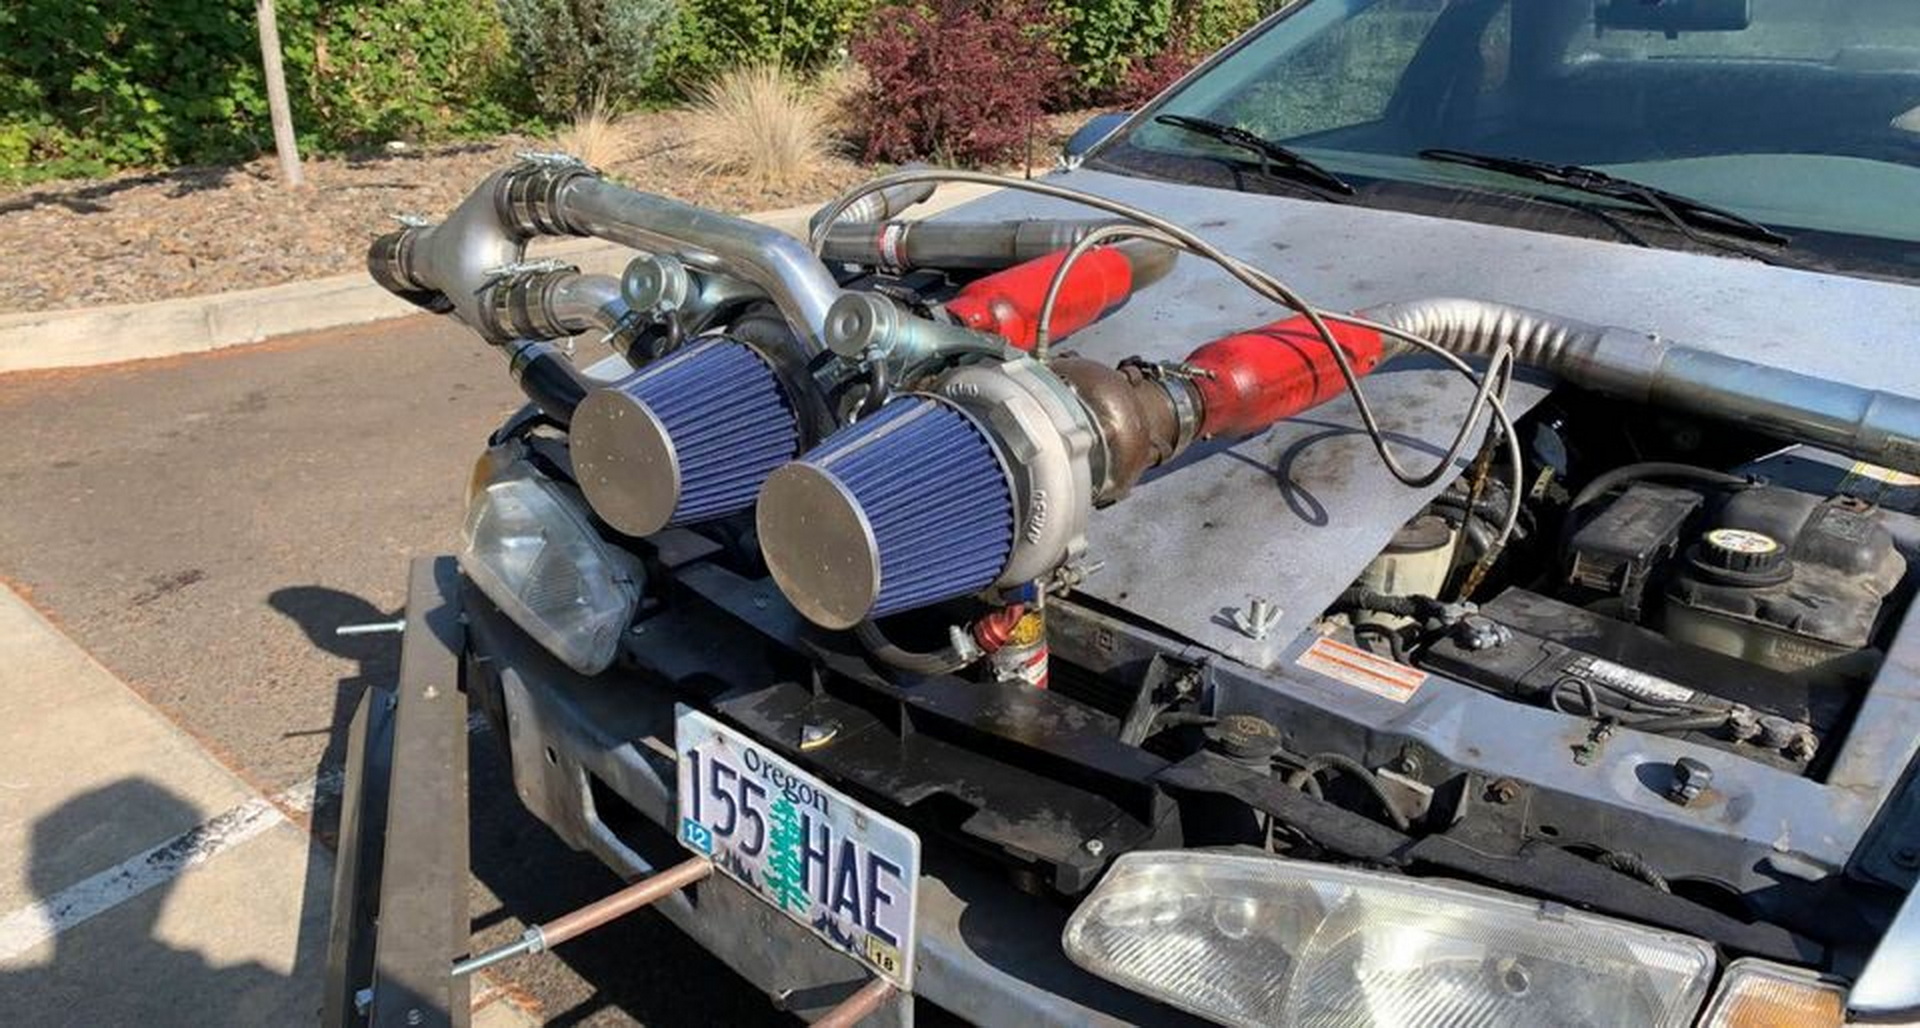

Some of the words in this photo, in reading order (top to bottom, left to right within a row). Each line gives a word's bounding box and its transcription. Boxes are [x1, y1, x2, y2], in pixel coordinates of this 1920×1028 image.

[743, 747, 830, 816] Oregon
[686, 823, 707, 847] 12
[687, 749, 766, 857] 155
[801, 811, 902, 947] HAE
[875, 951, 894, 971] 18
